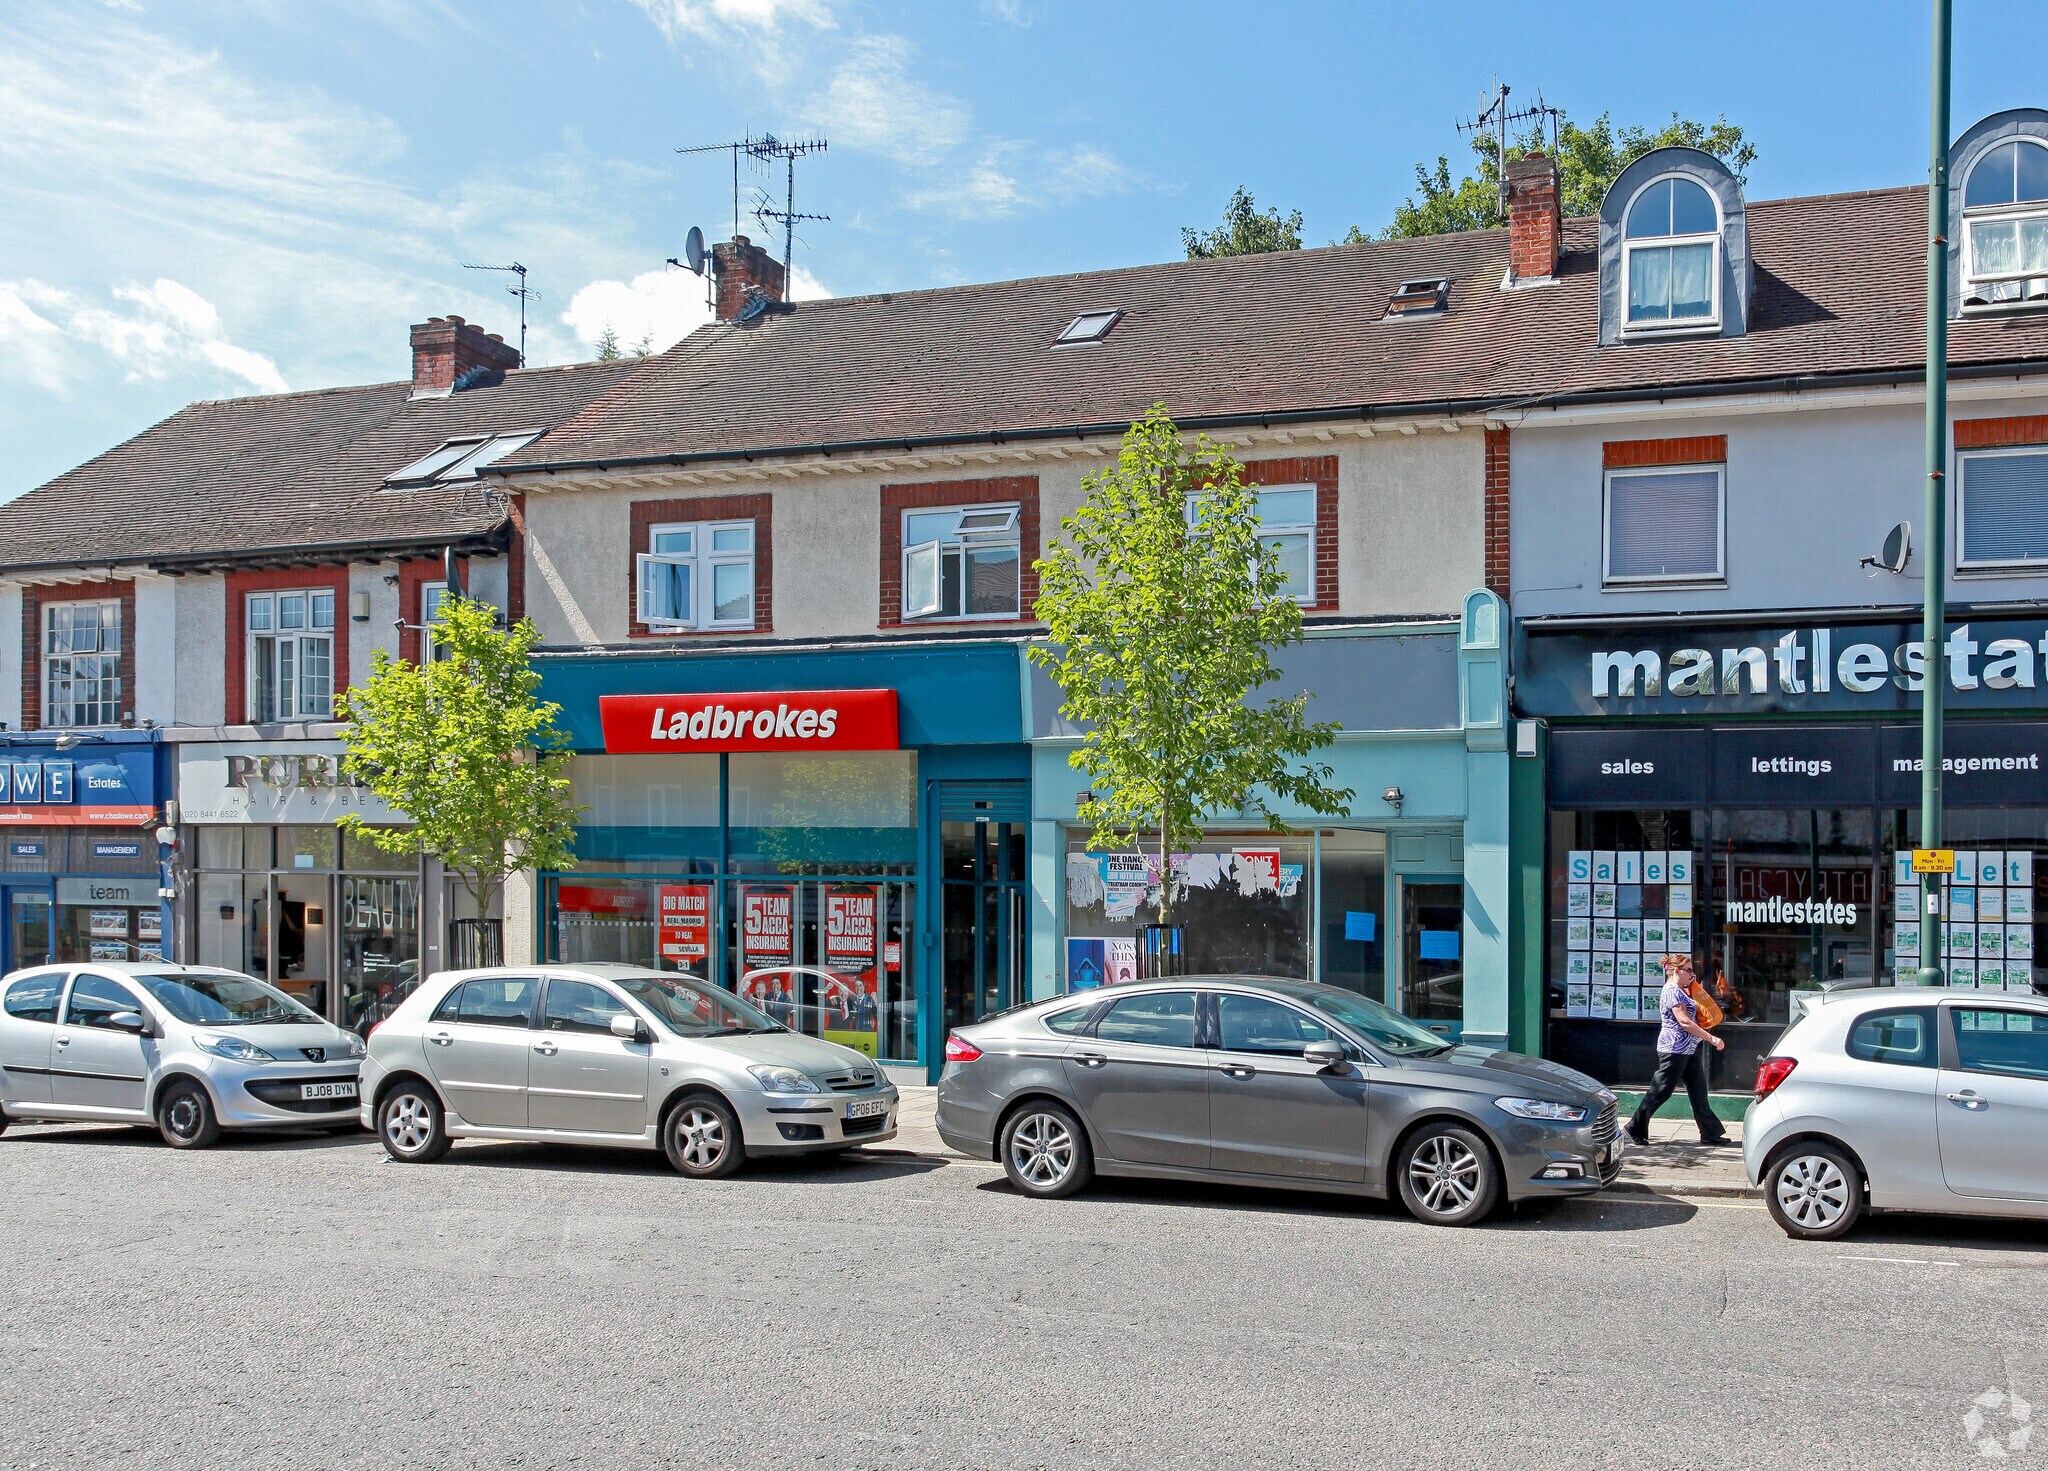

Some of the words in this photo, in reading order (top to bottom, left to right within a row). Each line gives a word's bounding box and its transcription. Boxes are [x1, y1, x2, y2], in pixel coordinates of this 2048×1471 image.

[1592, 623, 2048, 699] mantlesta
[650, 704, 838, 740] Ladbrokes
[1601, 758, 1655, 774] sales
[1751, 756, 1832, 776] lettings
[1893, 752, 2039, 775] maagement
[88, 776, 122, 789] Estates
[232, 796, 287, 805] HAIR
[184, 810, 198, 818] 020
[200, 810, 217, 818] 8441
[220, 810, 238, 818] 6522
[96, 846, 138, 854] MANAGEMENT
[1109, 863, 1144, 871] FESTIVAL
[1573, 858, 1686, 879] Sales
[1956, 860, 2020, 881] Let
[89, 884, 130, 900] team
[343, 879, 420, 930] BEAUTY
[663, 895, 677, 911] BIG
[677, 895, 705, 911] MATCH
[1726, 895, 1857, 925] mantlestates
[666, 915, 680, 924] REAL
[680, 915, 702, 924] MADRID
[746, 897, 761, 934] 5
[761, 897, 789, 916] TEAM
[828, 897, 844, 936] 5
[845, 897, 873, 917] TEAM
[761, 916, 789, 935] ACCA
[844, 917, 873, 936] ACCA
[746, 935, 789, 951] INSURANCE
[828, 936, 873, 952] INSURANCE
[306, 1085, 333, 1098] BJ08
[335, 1083, 353, 1095] DYN
[851, 1103, 870, 1117] GP06
[871, 1101, 885, 1114] EFC
